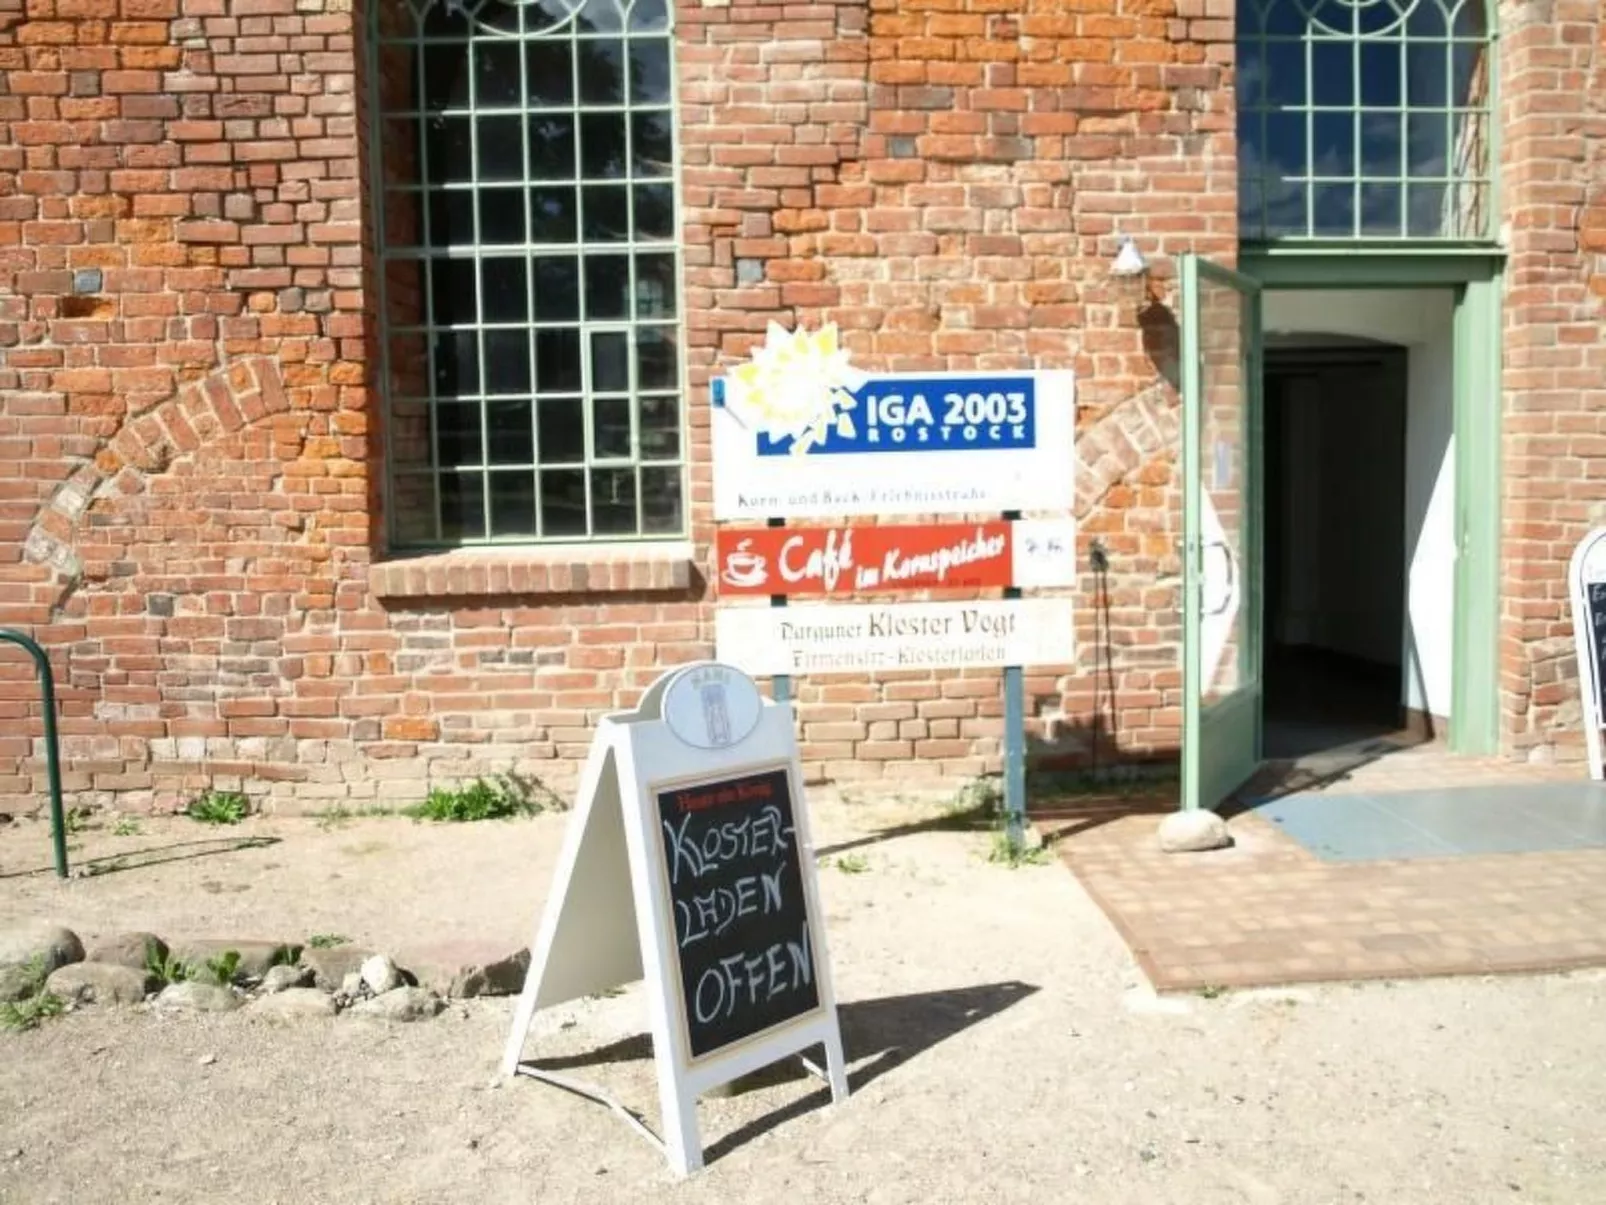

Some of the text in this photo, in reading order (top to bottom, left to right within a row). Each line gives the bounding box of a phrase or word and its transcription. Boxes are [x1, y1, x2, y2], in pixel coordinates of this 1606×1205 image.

[867, 392, 1027, 426] IGA 2003
[867, 425, 1025, 442] ROSTOCK
[778, 526, 1006, 592] Café im Kornspeicher
[868, 611, 954, 638] Kloster
[961, 609, 1016, 639] Vogt
[663, 804, 796, 884] KLOSTER-
[676, 860, 787, 949] LADEN
[695, 919, 811, 1024] OFFEN
